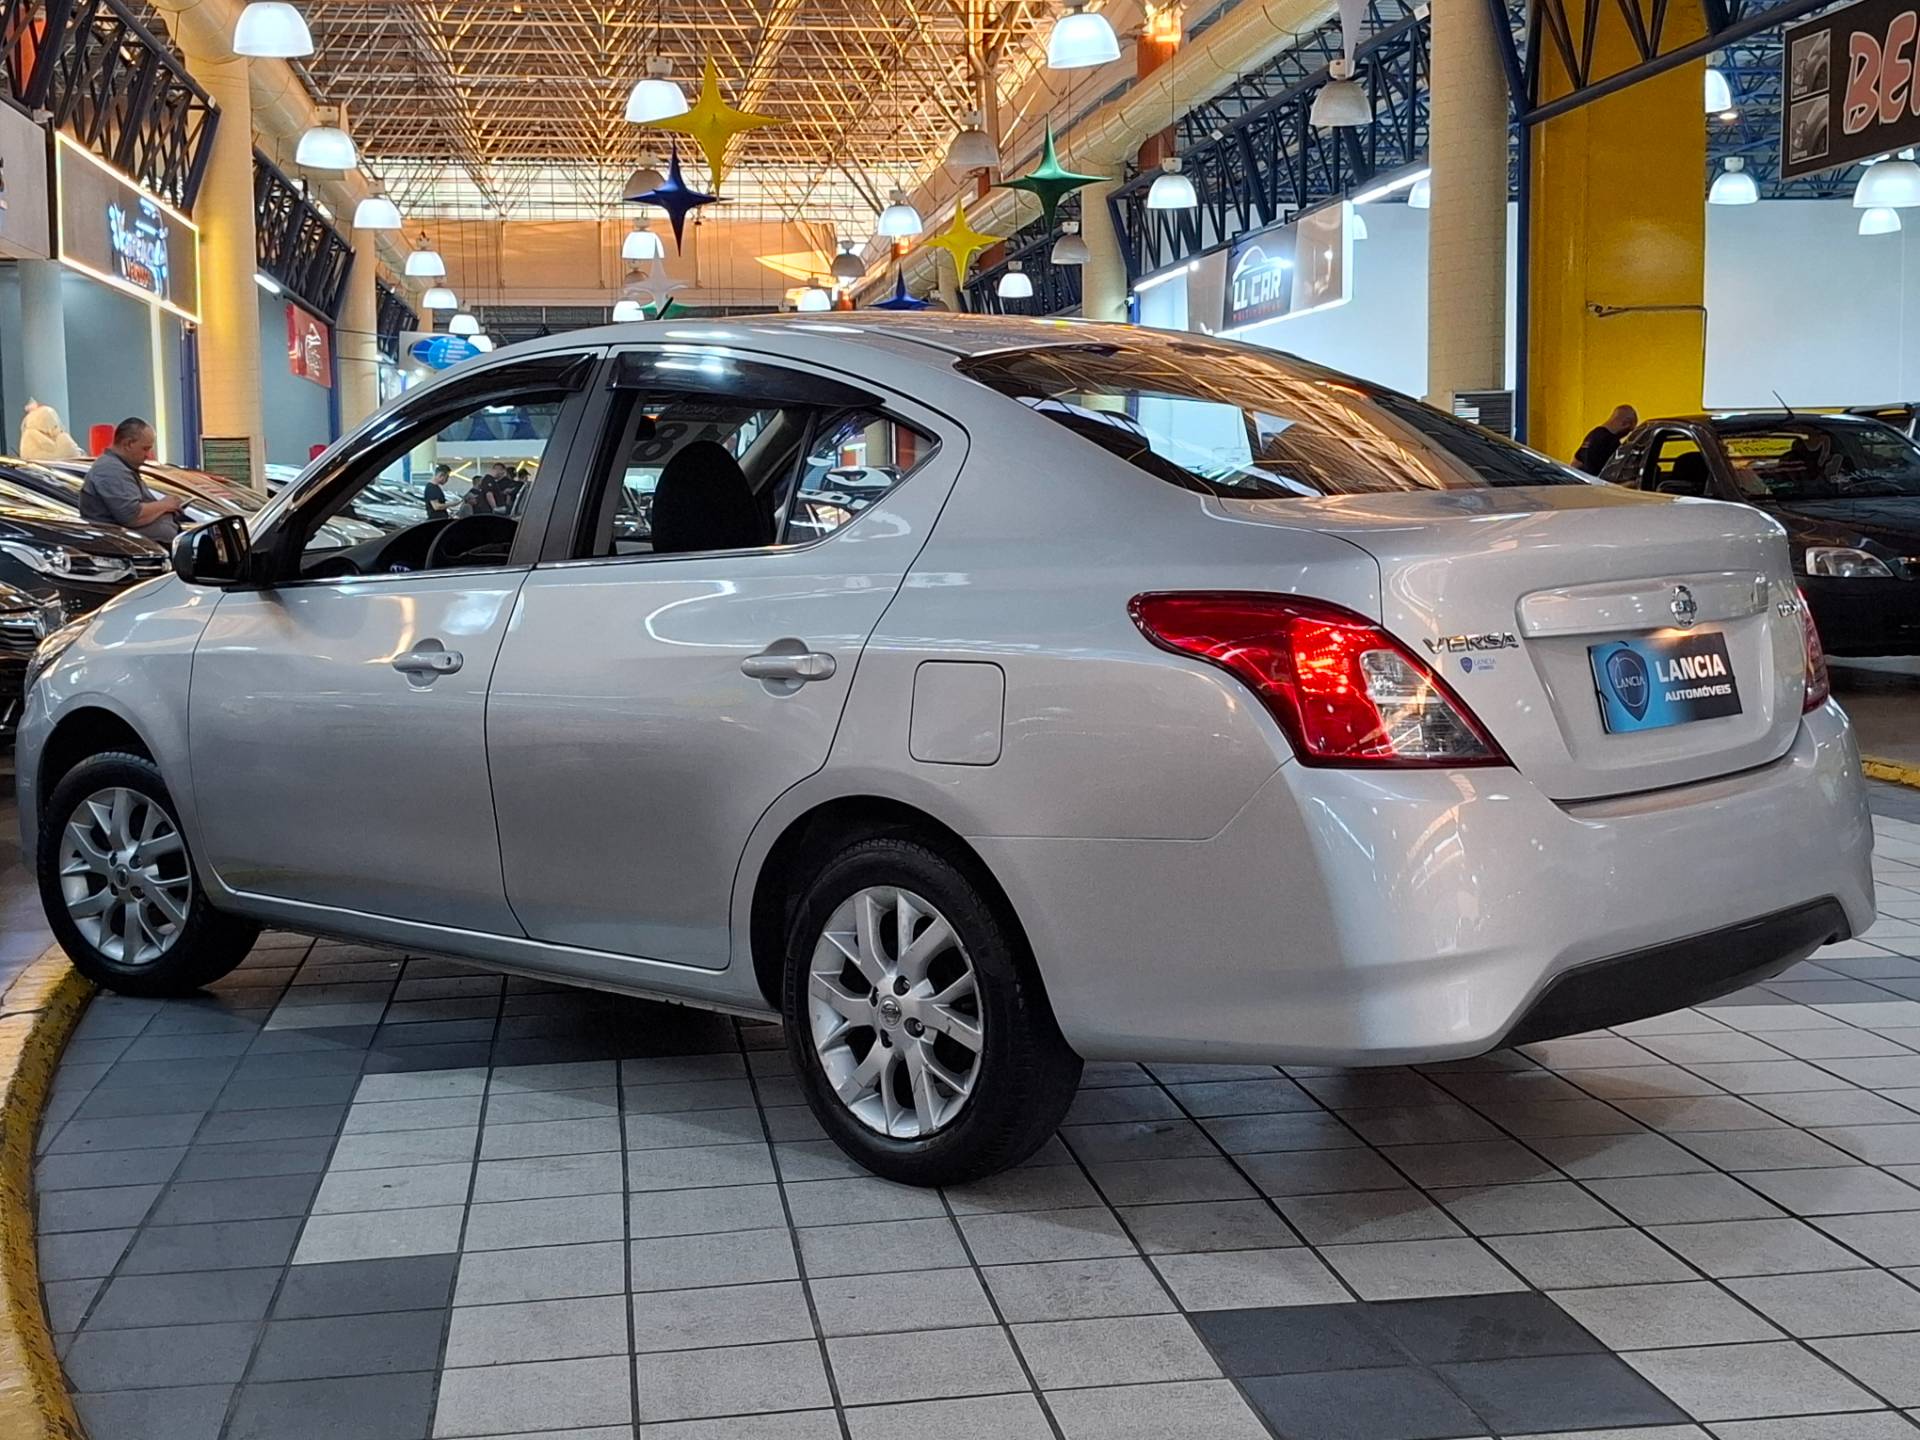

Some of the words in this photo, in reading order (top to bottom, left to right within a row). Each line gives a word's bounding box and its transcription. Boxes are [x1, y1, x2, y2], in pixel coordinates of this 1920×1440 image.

[1233, 280, 1248, 311] LL
[1251, 268, 1282, 306] CAR
[1422, 631, 1519, 654] VERSA
[1655, 653, 1727, 683] LANCIA
[1614, 676, 1646, 689] LANCIA
[1664, 683, 1732, 702] AUTOMÓVEIS
